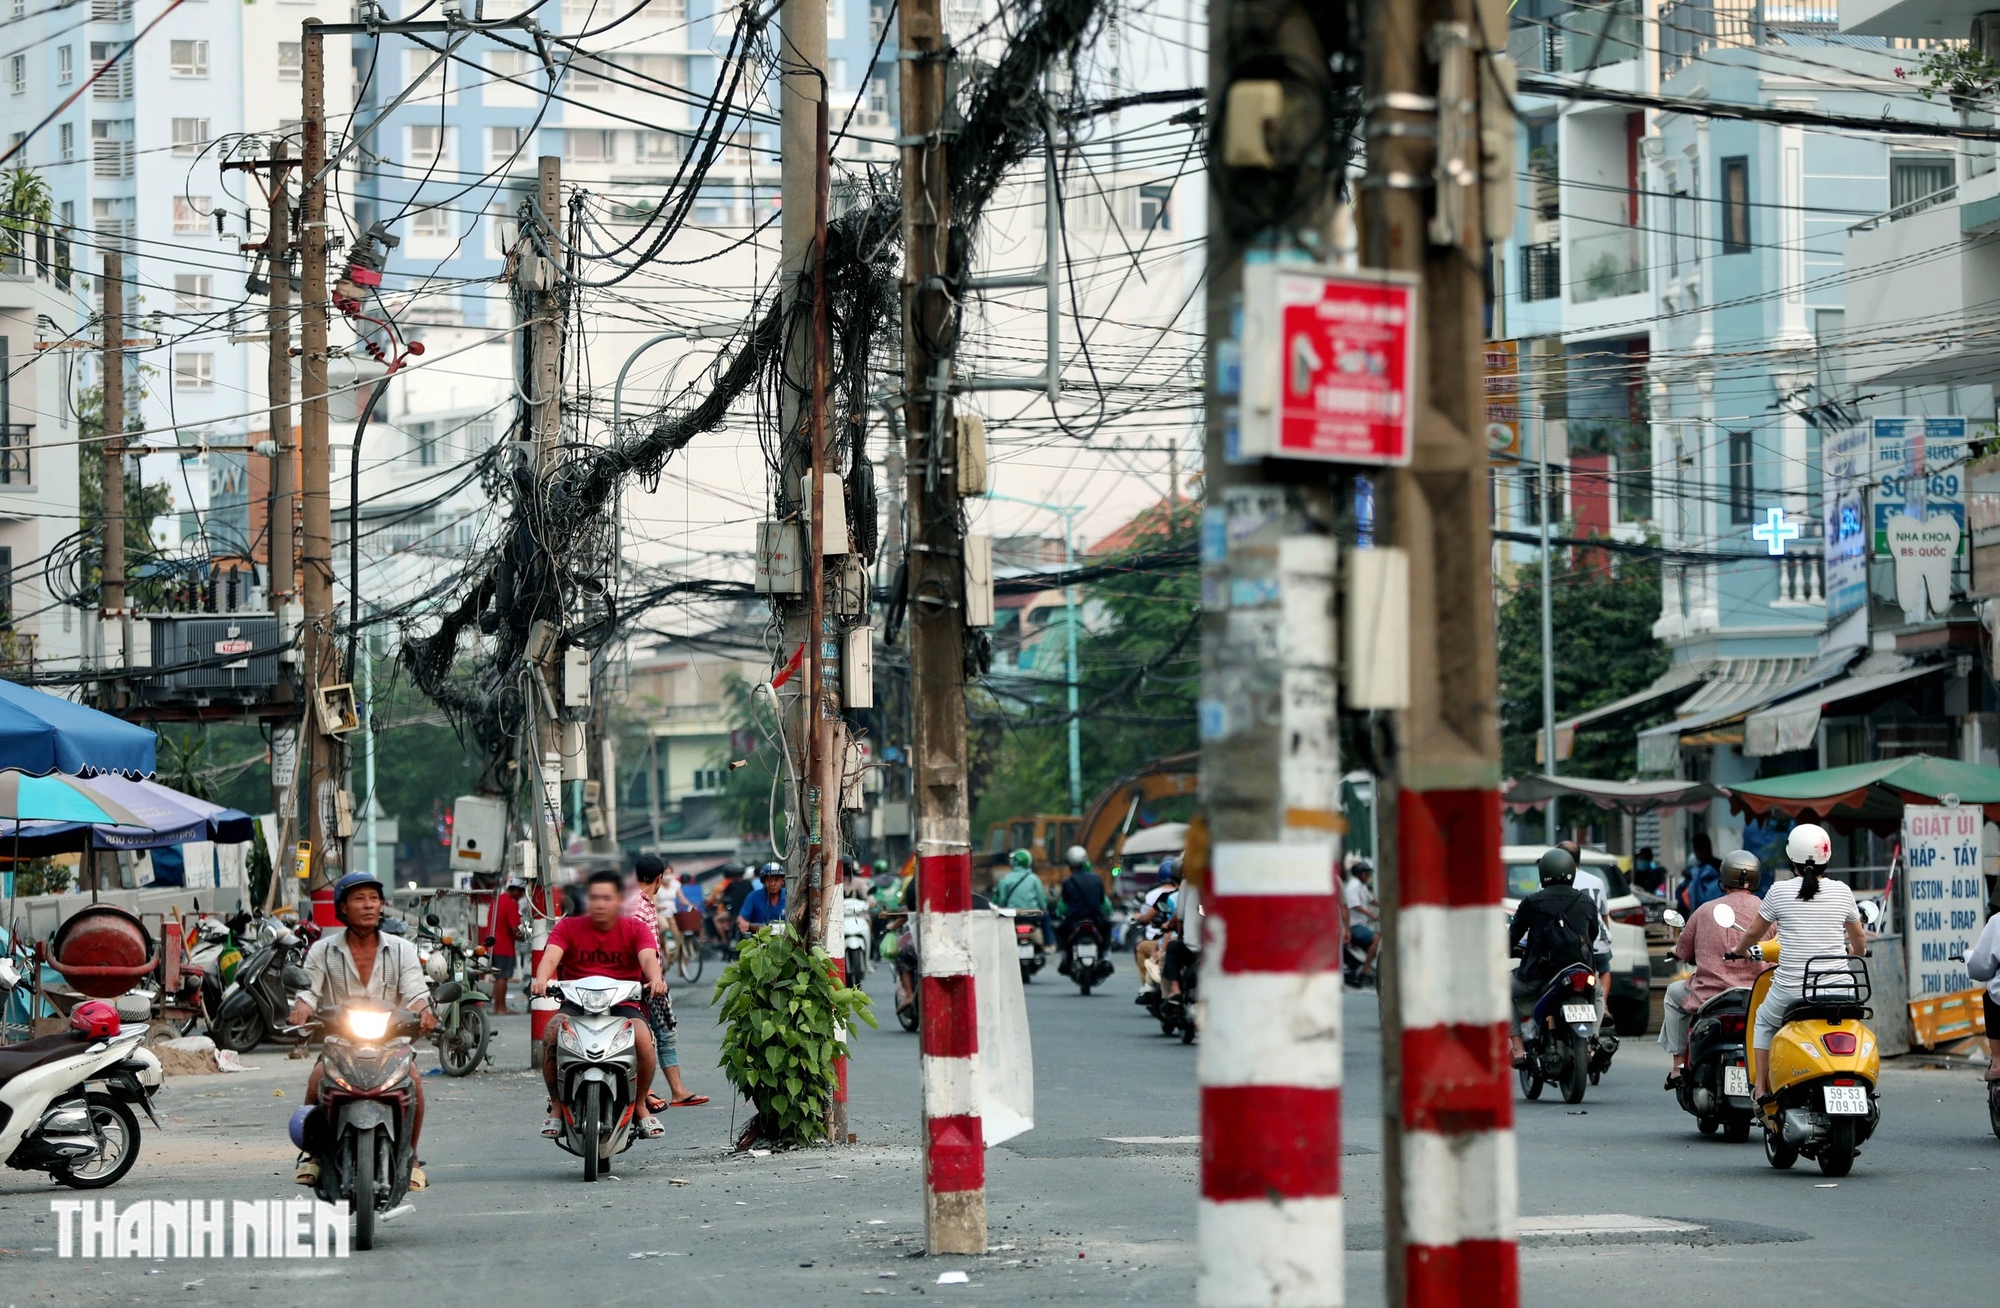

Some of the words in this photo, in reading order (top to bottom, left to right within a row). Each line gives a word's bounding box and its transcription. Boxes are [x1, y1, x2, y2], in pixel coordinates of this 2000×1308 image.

[1880, 442, 1906, 464] HIỆ
[1926, 475, 1959, 498] 69
[1896, 533, 1919, 542] NHA
[1922, 532, 1952, 542] KHOA
[1901, 548, 1917, 556] BS:
[1918, 544, 1946, 557] QUỐC
[1912, 812, 1951, 840] GIẶT
[1956, 808, 1975, 835] ỦI
[1909, 841, 1936, 868] HẤP
[1910, 880, 1943, 900] VESTON
[1951, 875, 1963, 899] ÁO
[1965, 875, 1980, 899] DÀI
[1914, 907, 1941, 931] CHĂN
[1950, 910, 1976, 930] DRAP
[579, 949, 622, 964] DIOR
[1922, 938, 1946, 962] MÀN
[1921, 970, 1941, 993] THÚ
[1730, 1069, 1746, 1081] 54-
[1730, 1082, 1749, 1094] 655
[1830, 1088, 1861, 1100] 59-S3
[1828, 1100, 1865, 1113] 709.16
